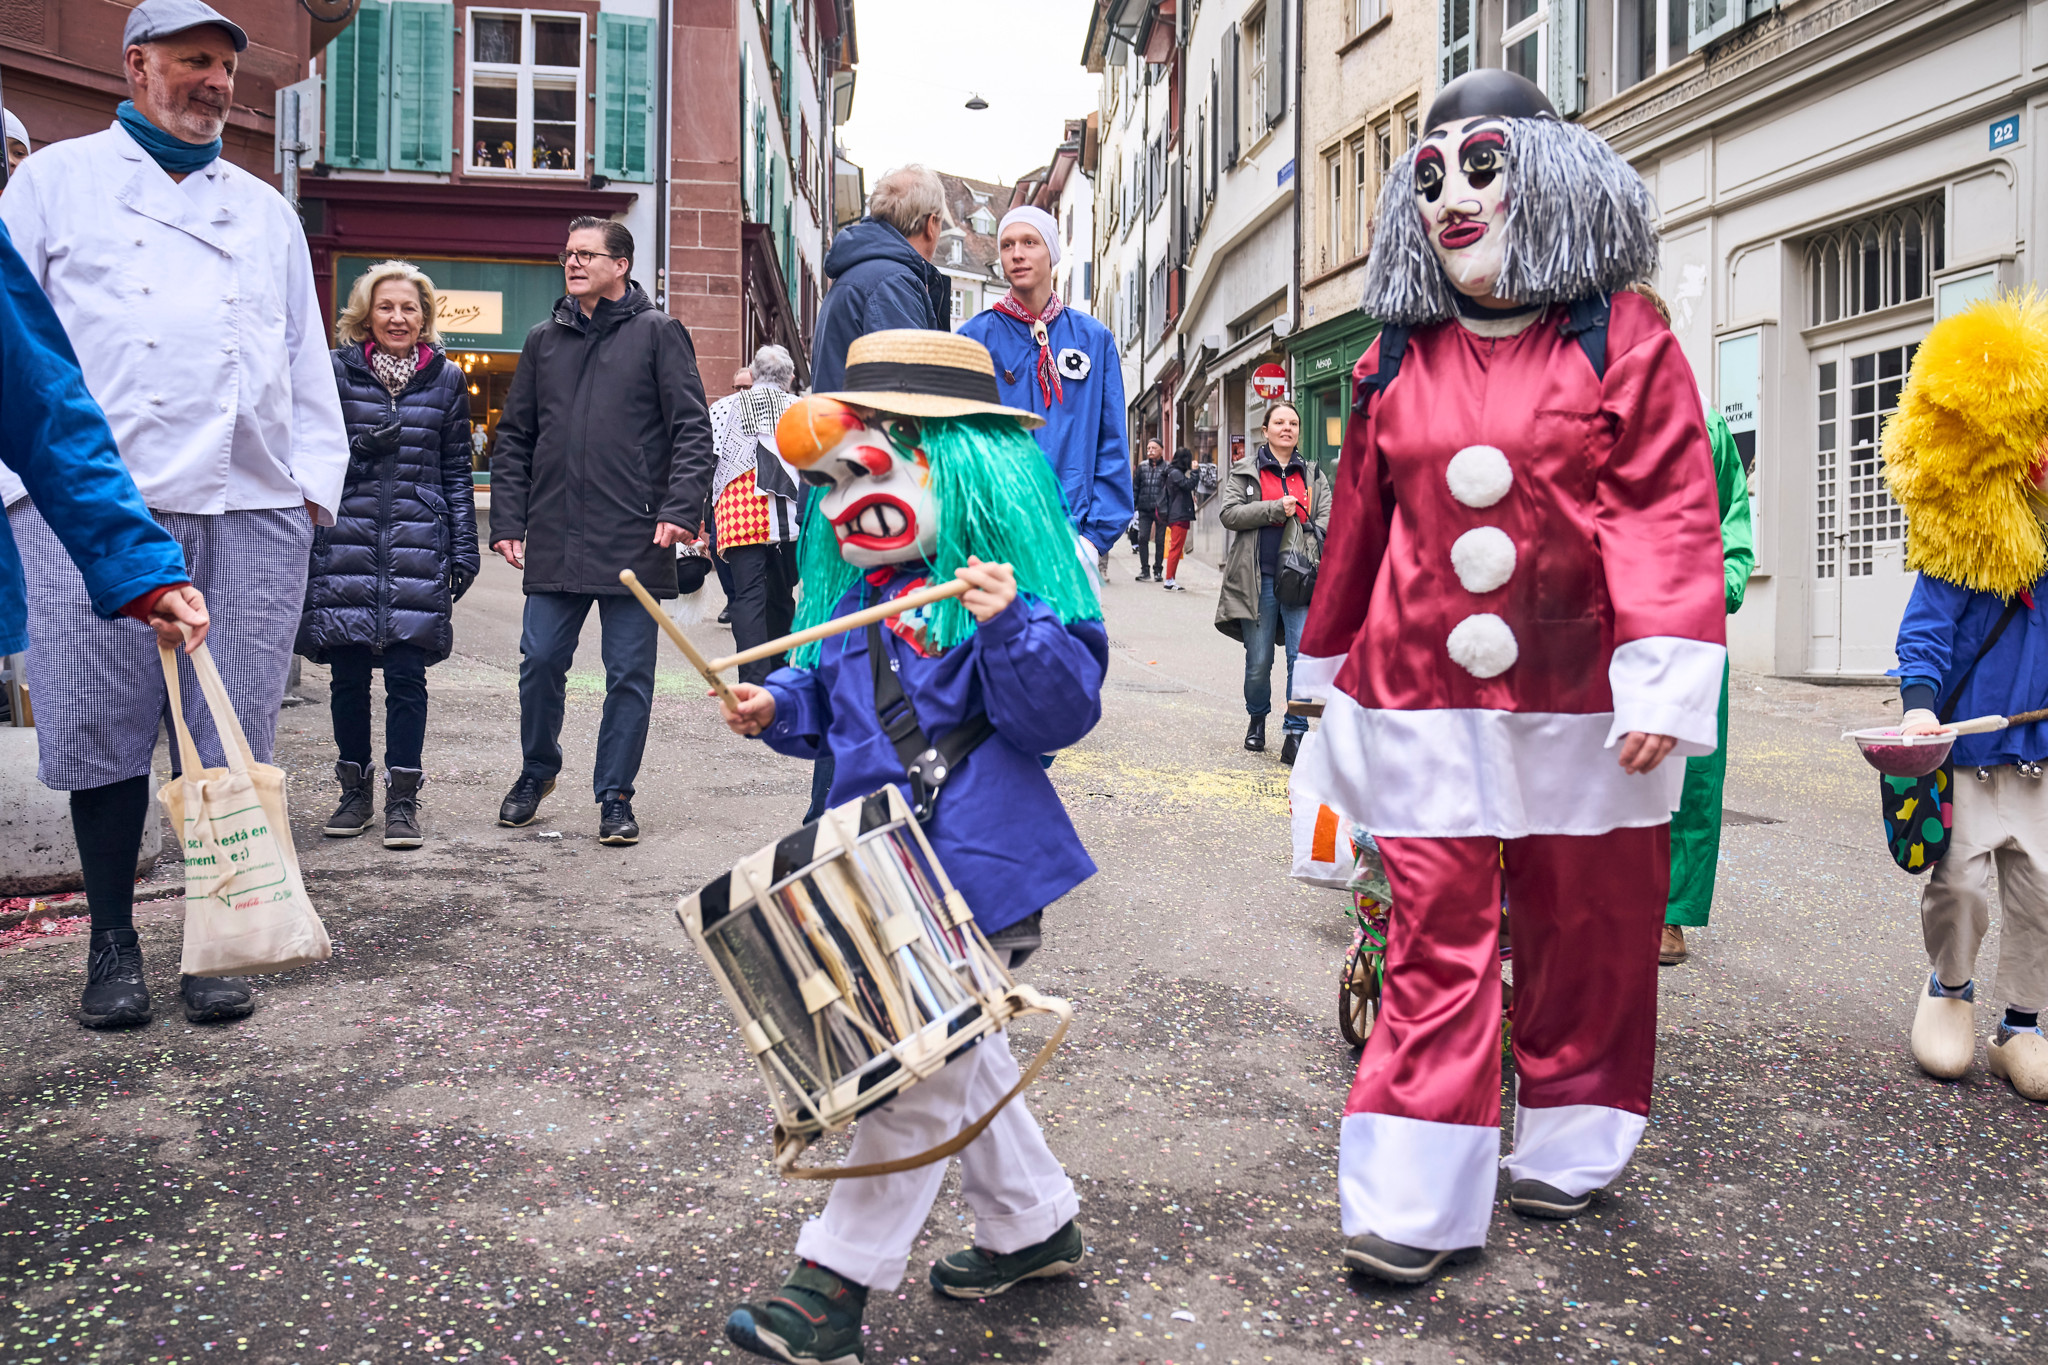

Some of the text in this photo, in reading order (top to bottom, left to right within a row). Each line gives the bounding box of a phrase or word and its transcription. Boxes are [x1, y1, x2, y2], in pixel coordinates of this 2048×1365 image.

[1994, 123, 2013, 144] 22
[1725, 410, 1753, 423] SACOCHE
[221, 828, 249, 847] está
[251, 825, 268, 838] en
